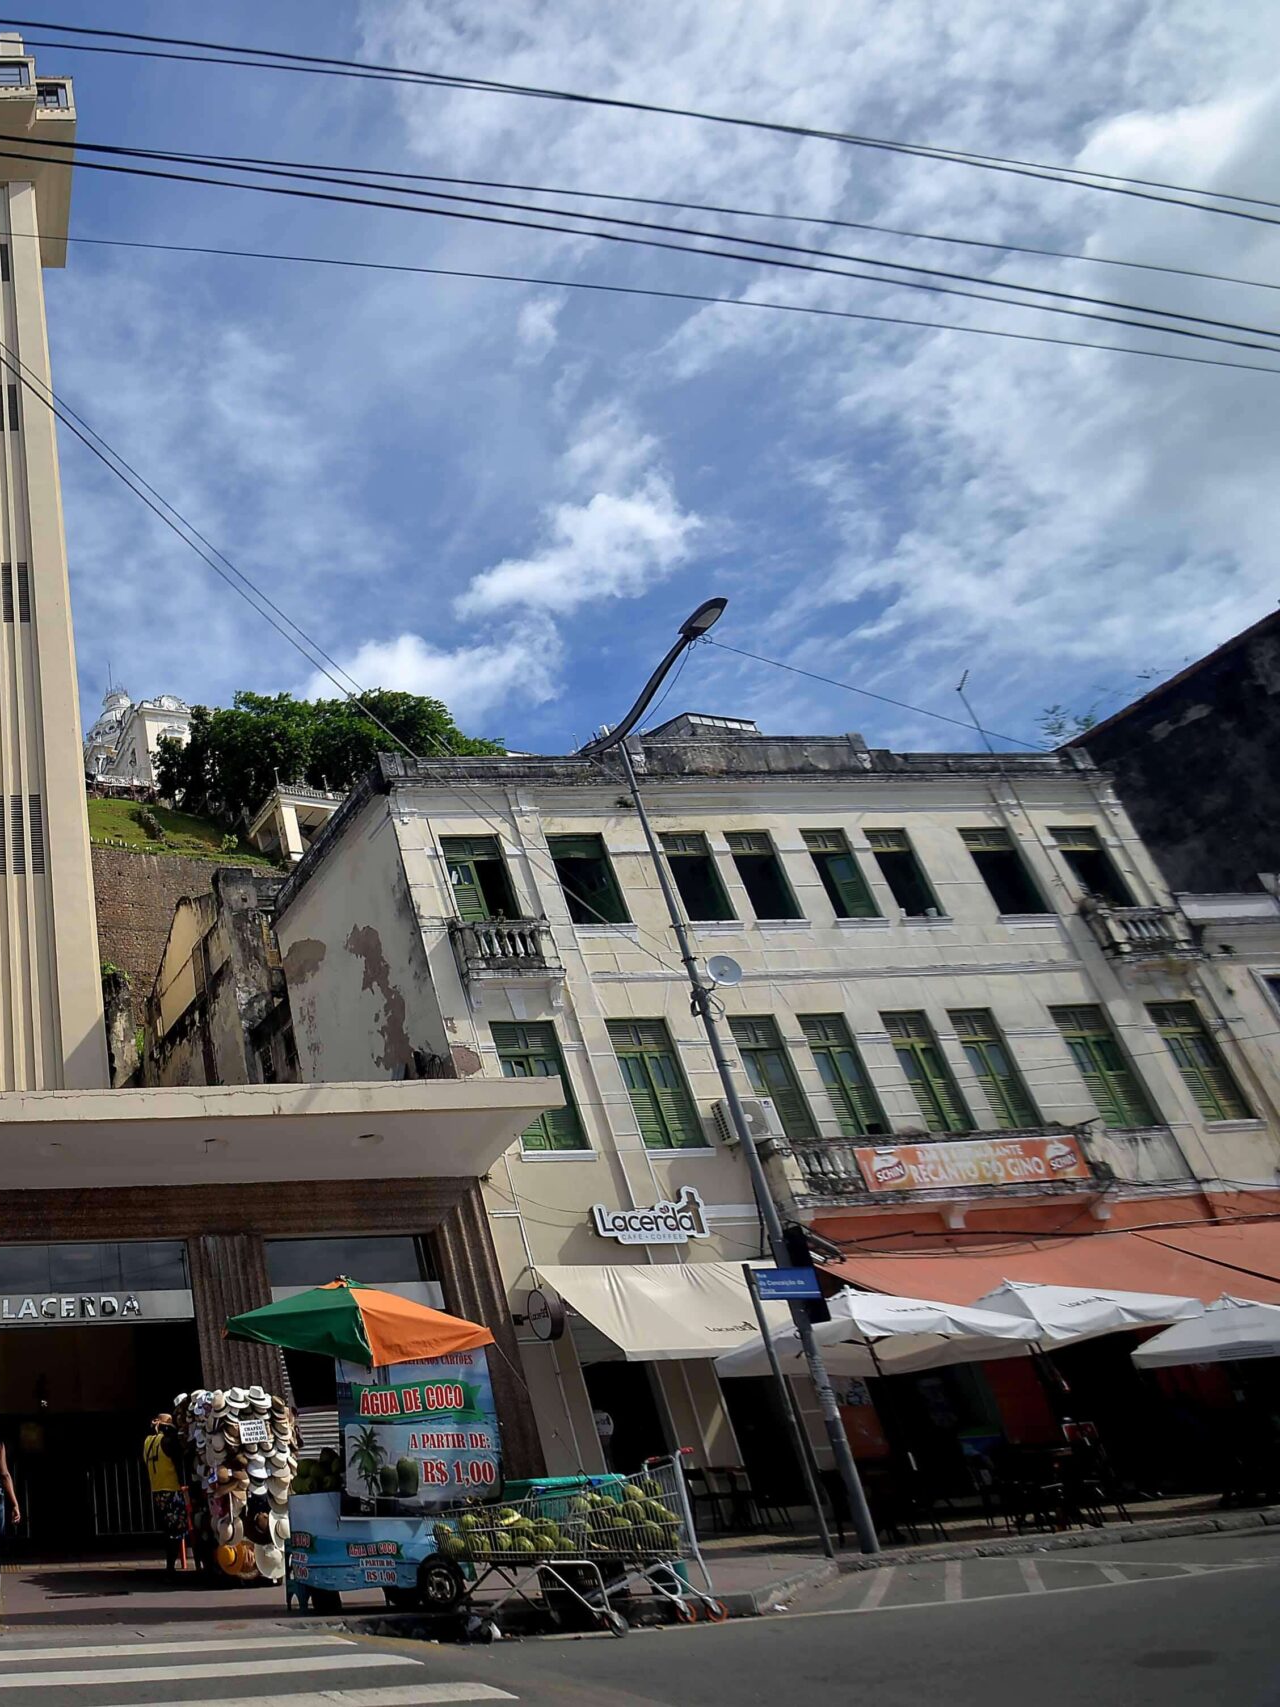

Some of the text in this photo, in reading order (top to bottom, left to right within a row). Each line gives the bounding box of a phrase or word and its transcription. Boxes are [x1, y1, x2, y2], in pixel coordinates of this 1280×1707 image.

[1008, 1156, 1045, 1176] GINO
[597, 1207, 696, 1232] Lacerda
[2, 1295, 142, 1320] LACERDA
[360, 1384, 464, 1416] ÁGUA DE COCO
[410, 1433, 491, 1449] A PARTIR DE:
[422, 1459, 495, 1487] R$ 1,00
